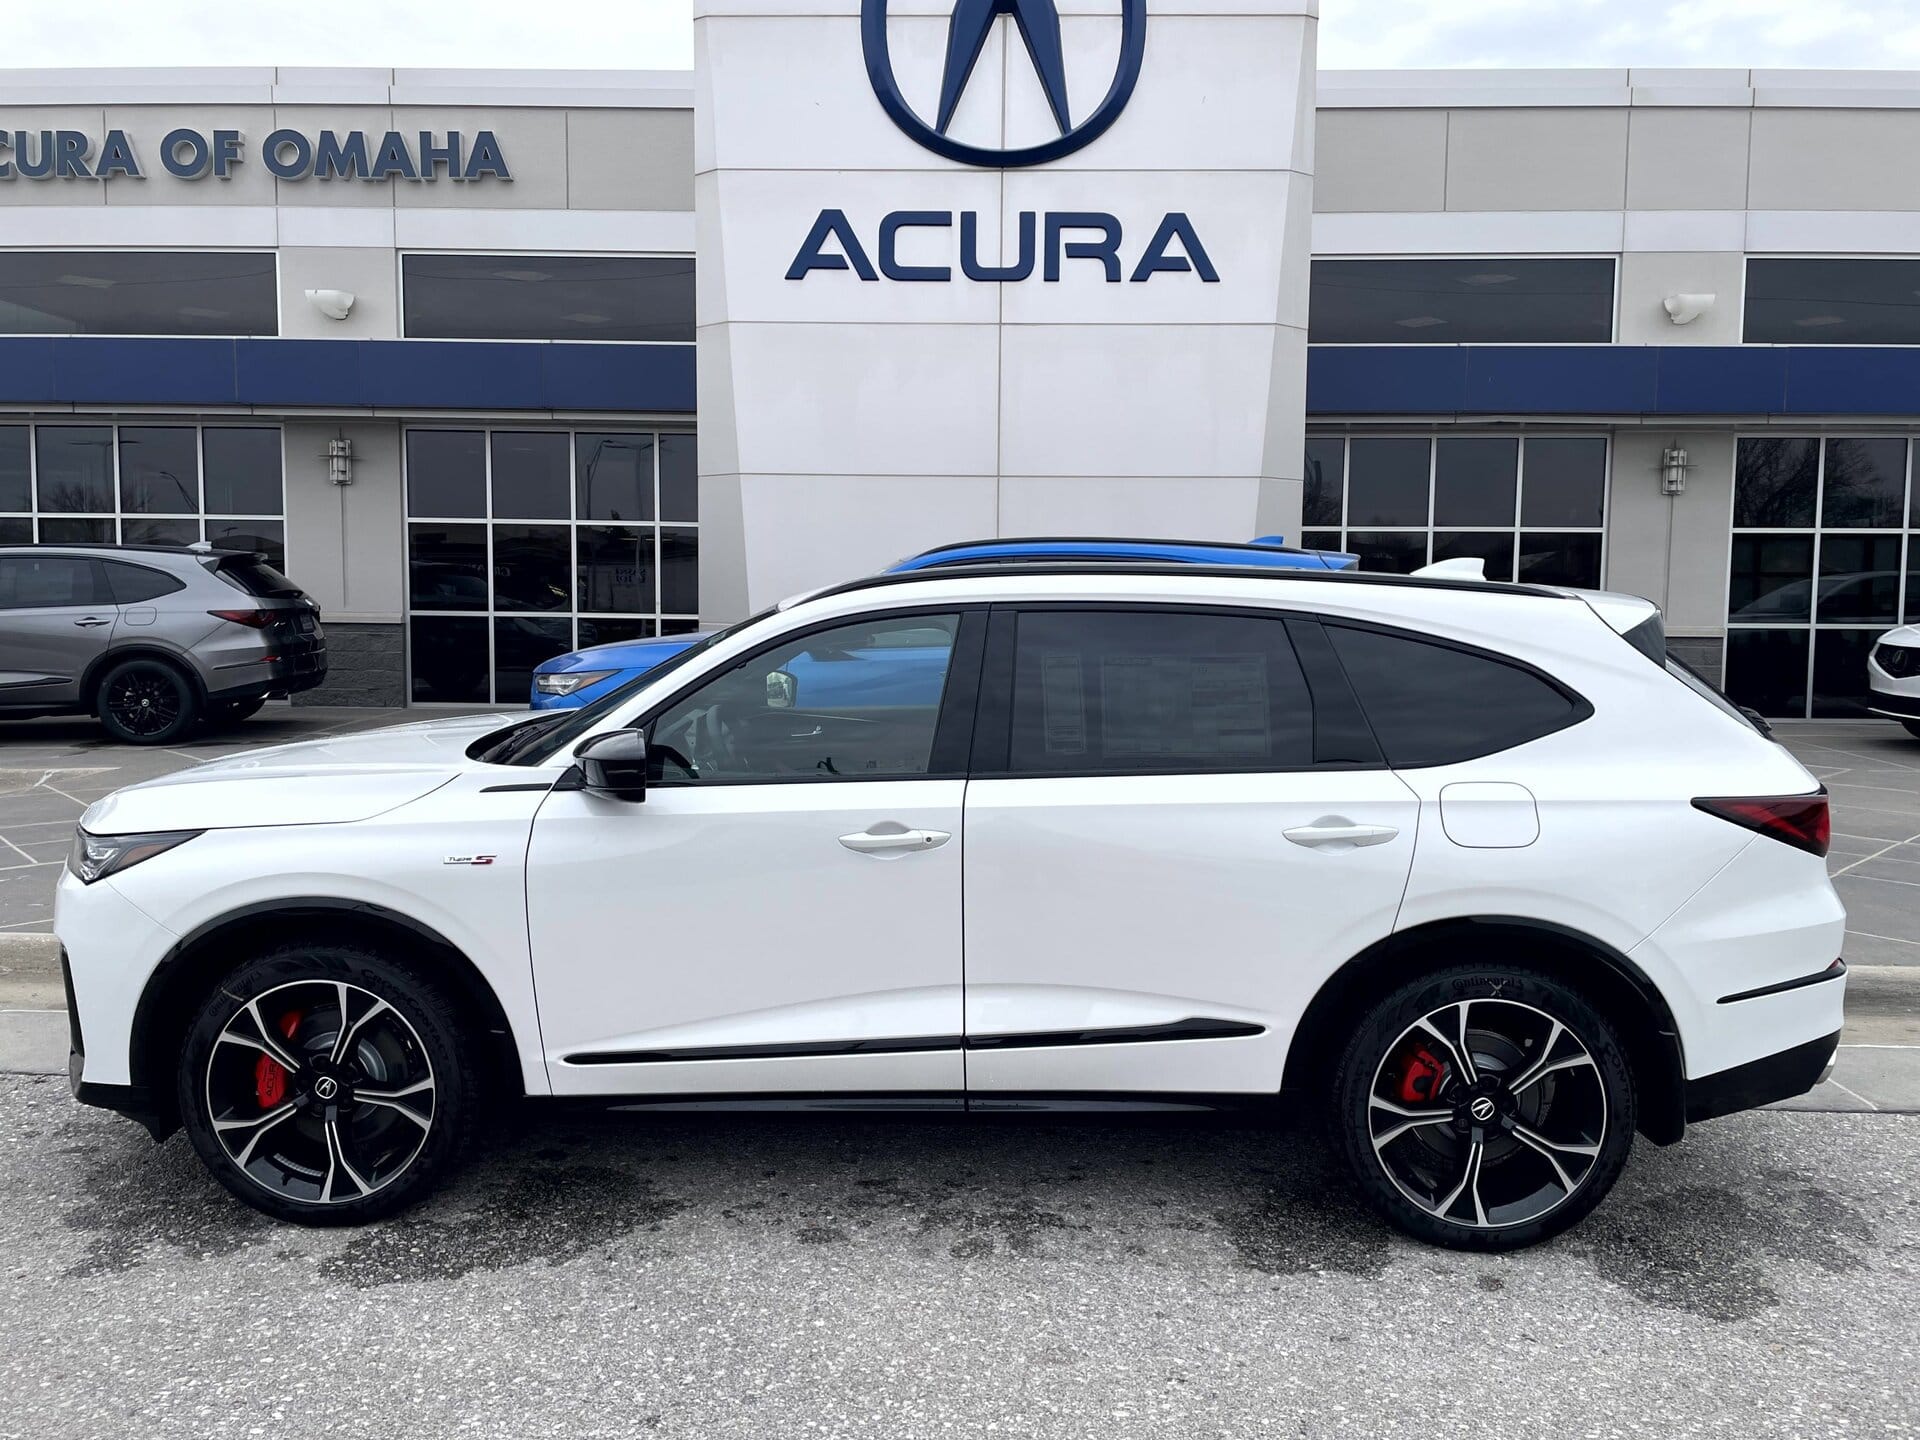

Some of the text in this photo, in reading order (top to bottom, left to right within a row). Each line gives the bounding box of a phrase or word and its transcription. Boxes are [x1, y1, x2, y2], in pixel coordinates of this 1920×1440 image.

[159, 128, 243, 180] OF
[261, 128, 513, 182] OMAHA
[784, 208, 1221, 283] ACURA
[471, 855, 497, 865] S
